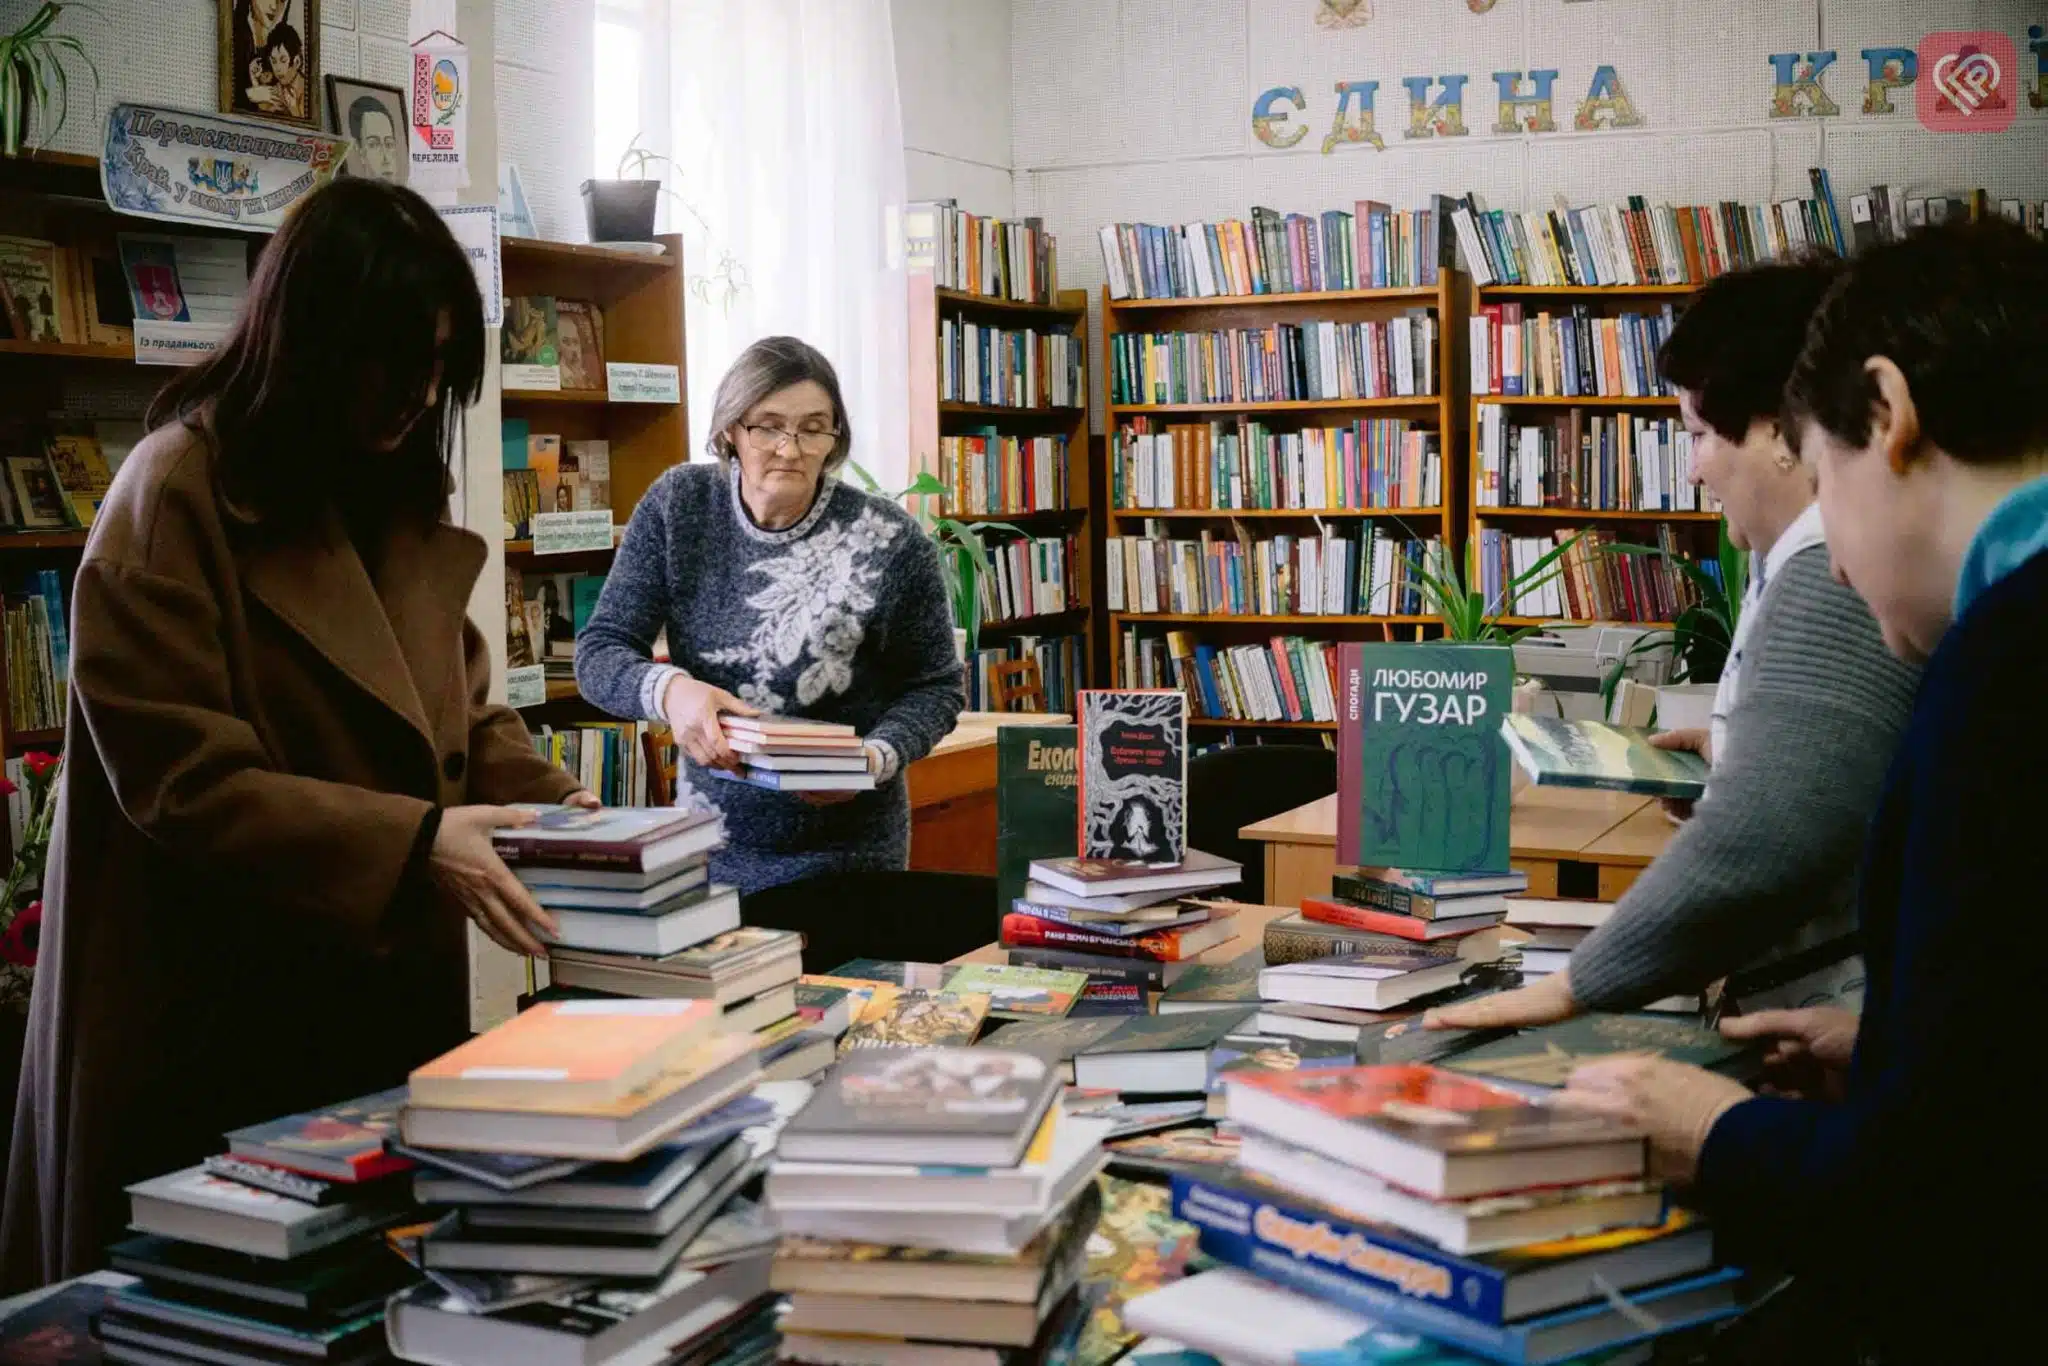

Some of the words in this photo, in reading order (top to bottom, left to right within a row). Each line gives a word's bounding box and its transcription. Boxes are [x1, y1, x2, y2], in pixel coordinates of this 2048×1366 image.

[1252, 65, 1643, 154] ЄДИНА
[123, 139, 172, 193] Край,
[174, 181, 188, 204] у
[188, 190, 240, 220] якому
[243, 197, 265, 215] ти
[263, 170, 315, 212] живеш
[152, 338, 215, 350] прадавнього
[1349, 668, 1362, 721] СПОГАДИ
[1372, 668, 1488, 691] ЛЮБОМИР
[1374, 691, 1488, 726] ГУЗАР
